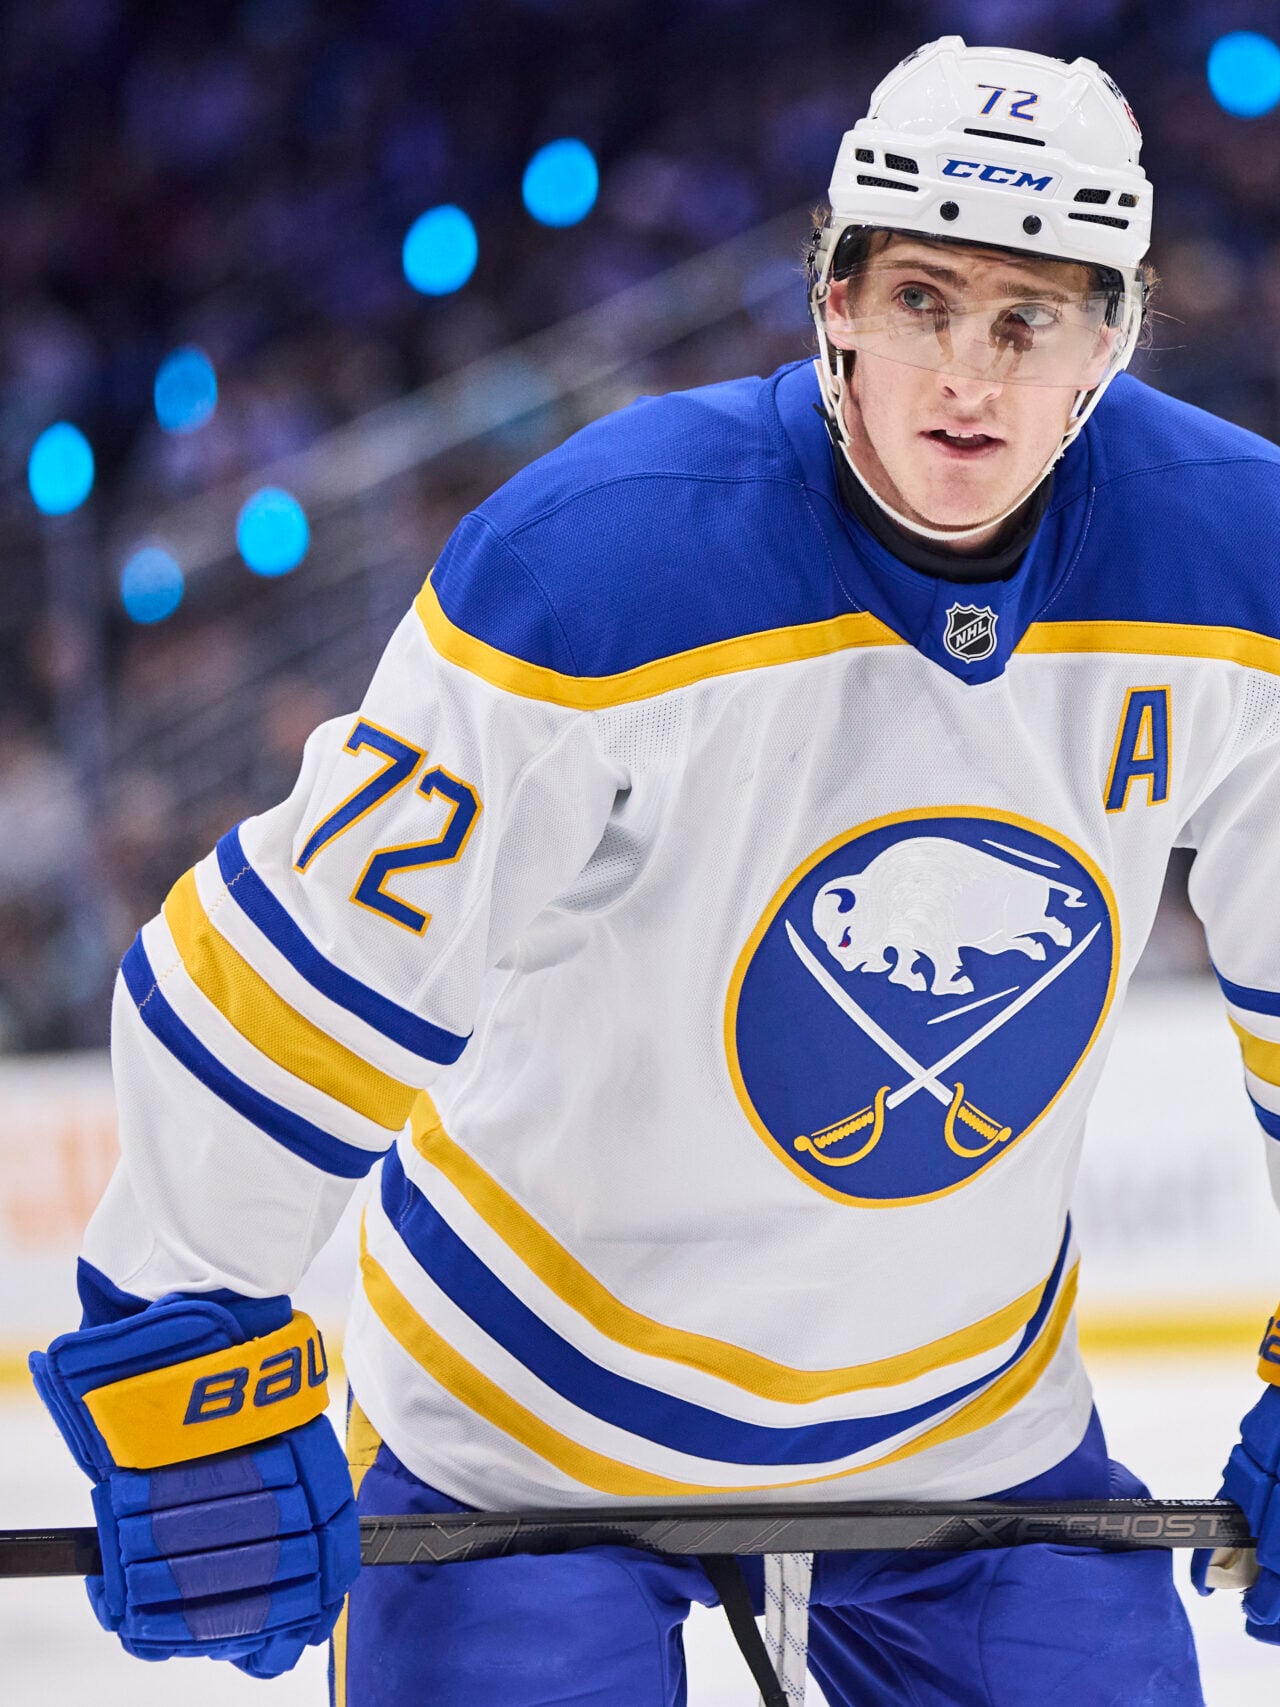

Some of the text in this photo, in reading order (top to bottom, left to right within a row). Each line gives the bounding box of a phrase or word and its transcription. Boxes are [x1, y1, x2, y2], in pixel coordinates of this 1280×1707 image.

[975, 83, 1040, 124] 72
[941, 158, 1054, 192] CCM
[954, 619, 988, 649] NHL
[1102, 683, 1172, 815] A
[292, 715, 485, 938] 72
